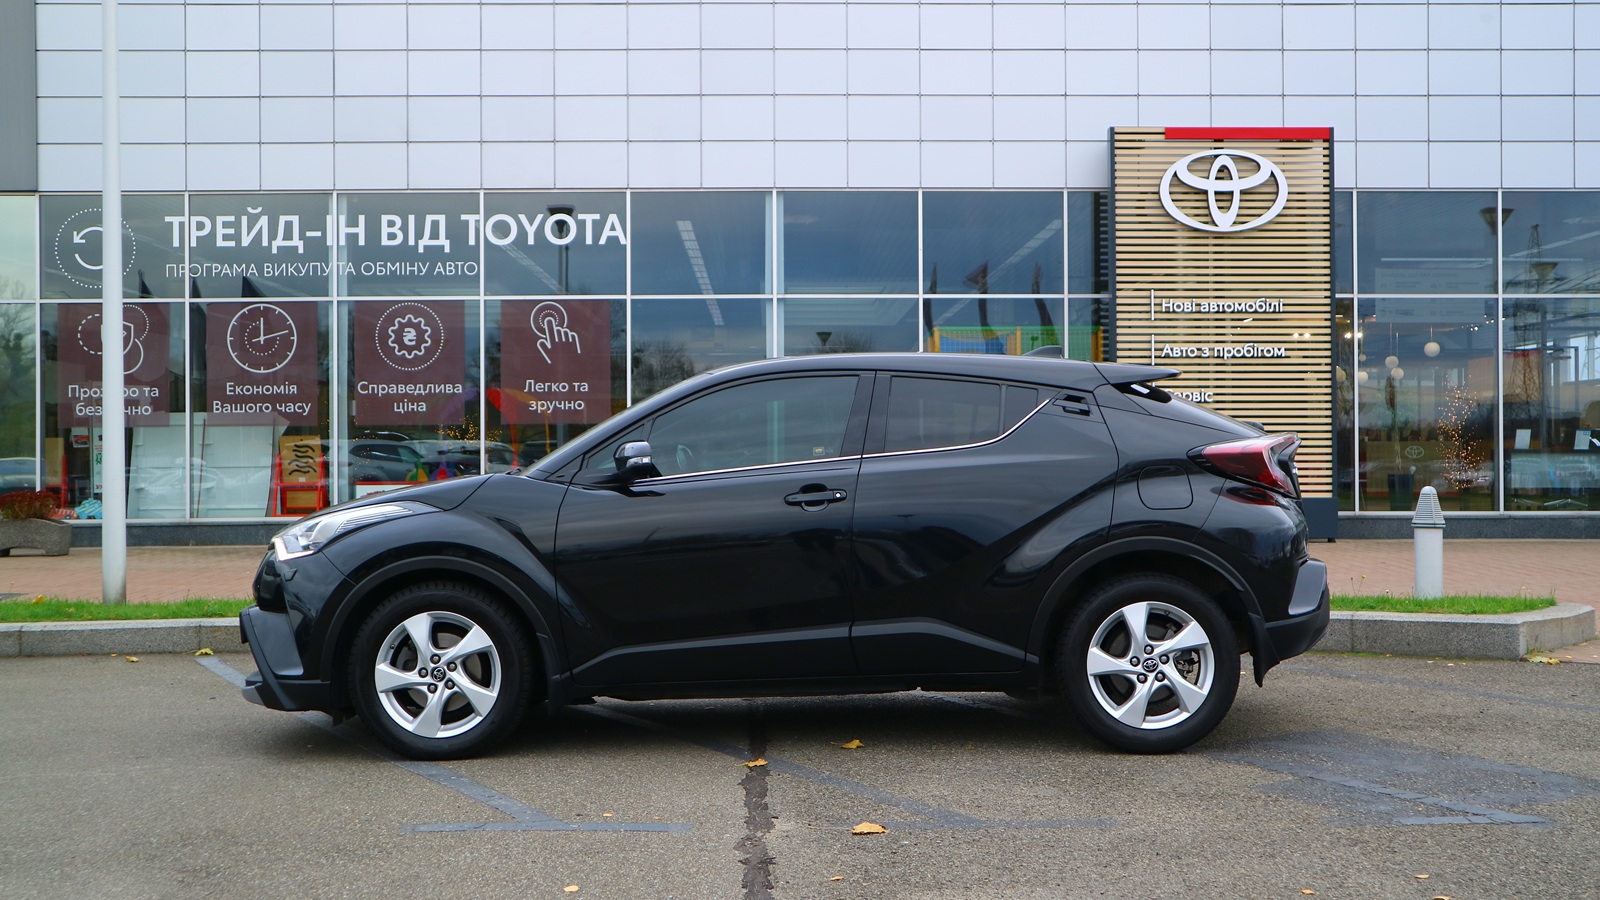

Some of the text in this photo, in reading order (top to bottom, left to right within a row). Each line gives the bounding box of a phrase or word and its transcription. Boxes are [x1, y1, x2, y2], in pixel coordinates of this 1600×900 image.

[165, 207, 627, 254] ТРЕЙД-ІН ВІД TOYOTA
[166, 261, 478, 278] ПРОГРАМА ВИКУПУ ТА ОБМІНУ АВТО
[1161, 298, 1283, 312] Нові автомобілі
[1161, 343, 1285, 360] Авто з пробігом
[68, 385, 159, 400] Проо та
[226, 382, 297, 395] Економія
[357, 381, 462, 397] Справедлива
[523, 379, 589, 393] Легко та
[1164, 389, 1214, 403] рвіс
[75, 402, 152, 416] безчно
[213, 401, 311, 416] Вашого часу
[393, 399, 426, 414] ціна
[528, 400, 585, 414] зручно
